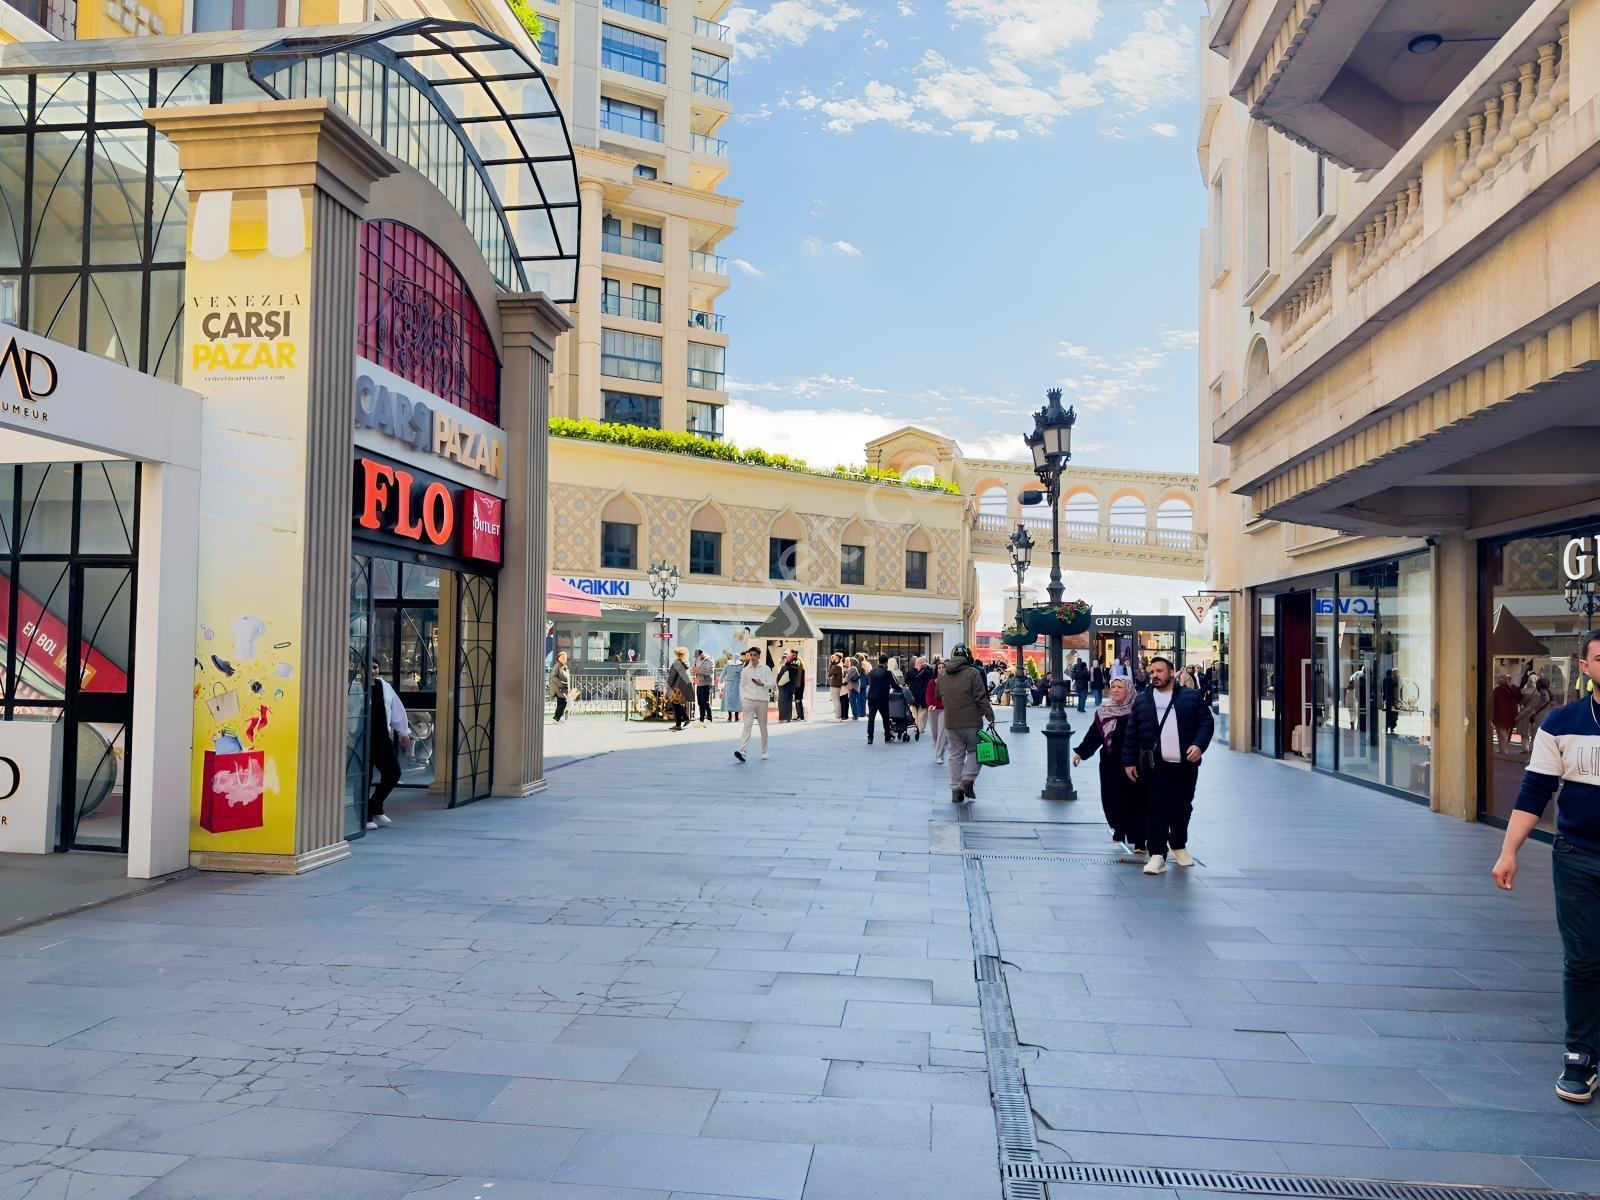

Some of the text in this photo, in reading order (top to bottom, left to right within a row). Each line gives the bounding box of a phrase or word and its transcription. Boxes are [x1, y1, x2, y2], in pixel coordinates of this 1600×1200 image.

[193, 294, 300, 308] VENEZIA
[202, 310, 291, 342] ÇARŞI
[192, 342, 297, 372] PAZAR
[433, 411, 504, 480] PAZAR
[360, 458, 454, 546] FLO
[474, 519, 500, 536] OUTLET
[1095, 617, 1132, 626] GUESS
[36, 632, 57, 657] BOL
